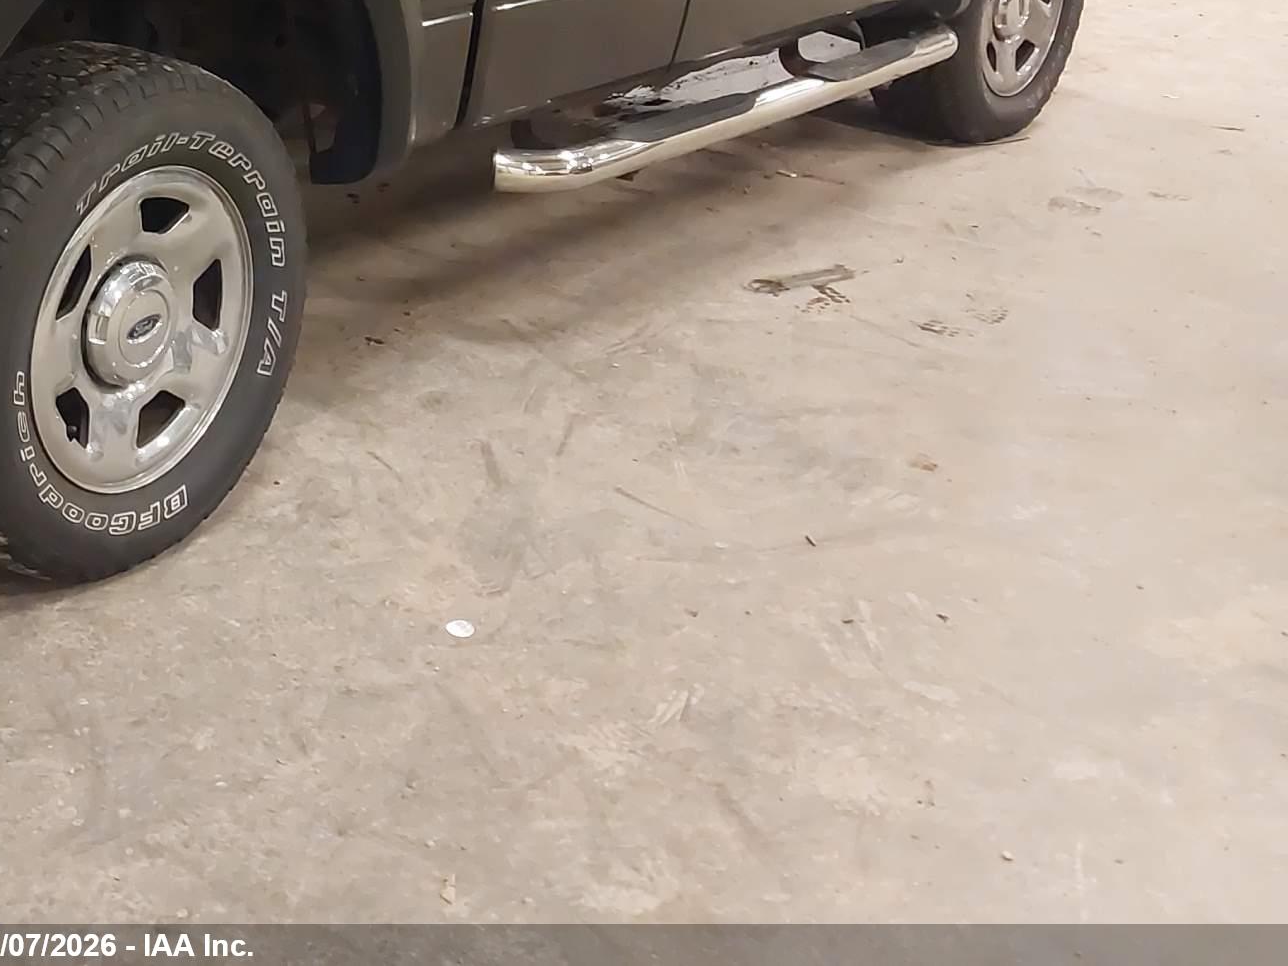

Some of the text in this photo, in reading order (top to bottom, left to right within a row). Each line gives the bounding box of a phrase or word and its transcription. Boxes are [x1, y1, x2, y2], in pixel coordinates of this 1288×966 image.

[75, 131, 288, 377] Trail-Terrain T/A
[13, 370, 189, 535] BFGoodrich
